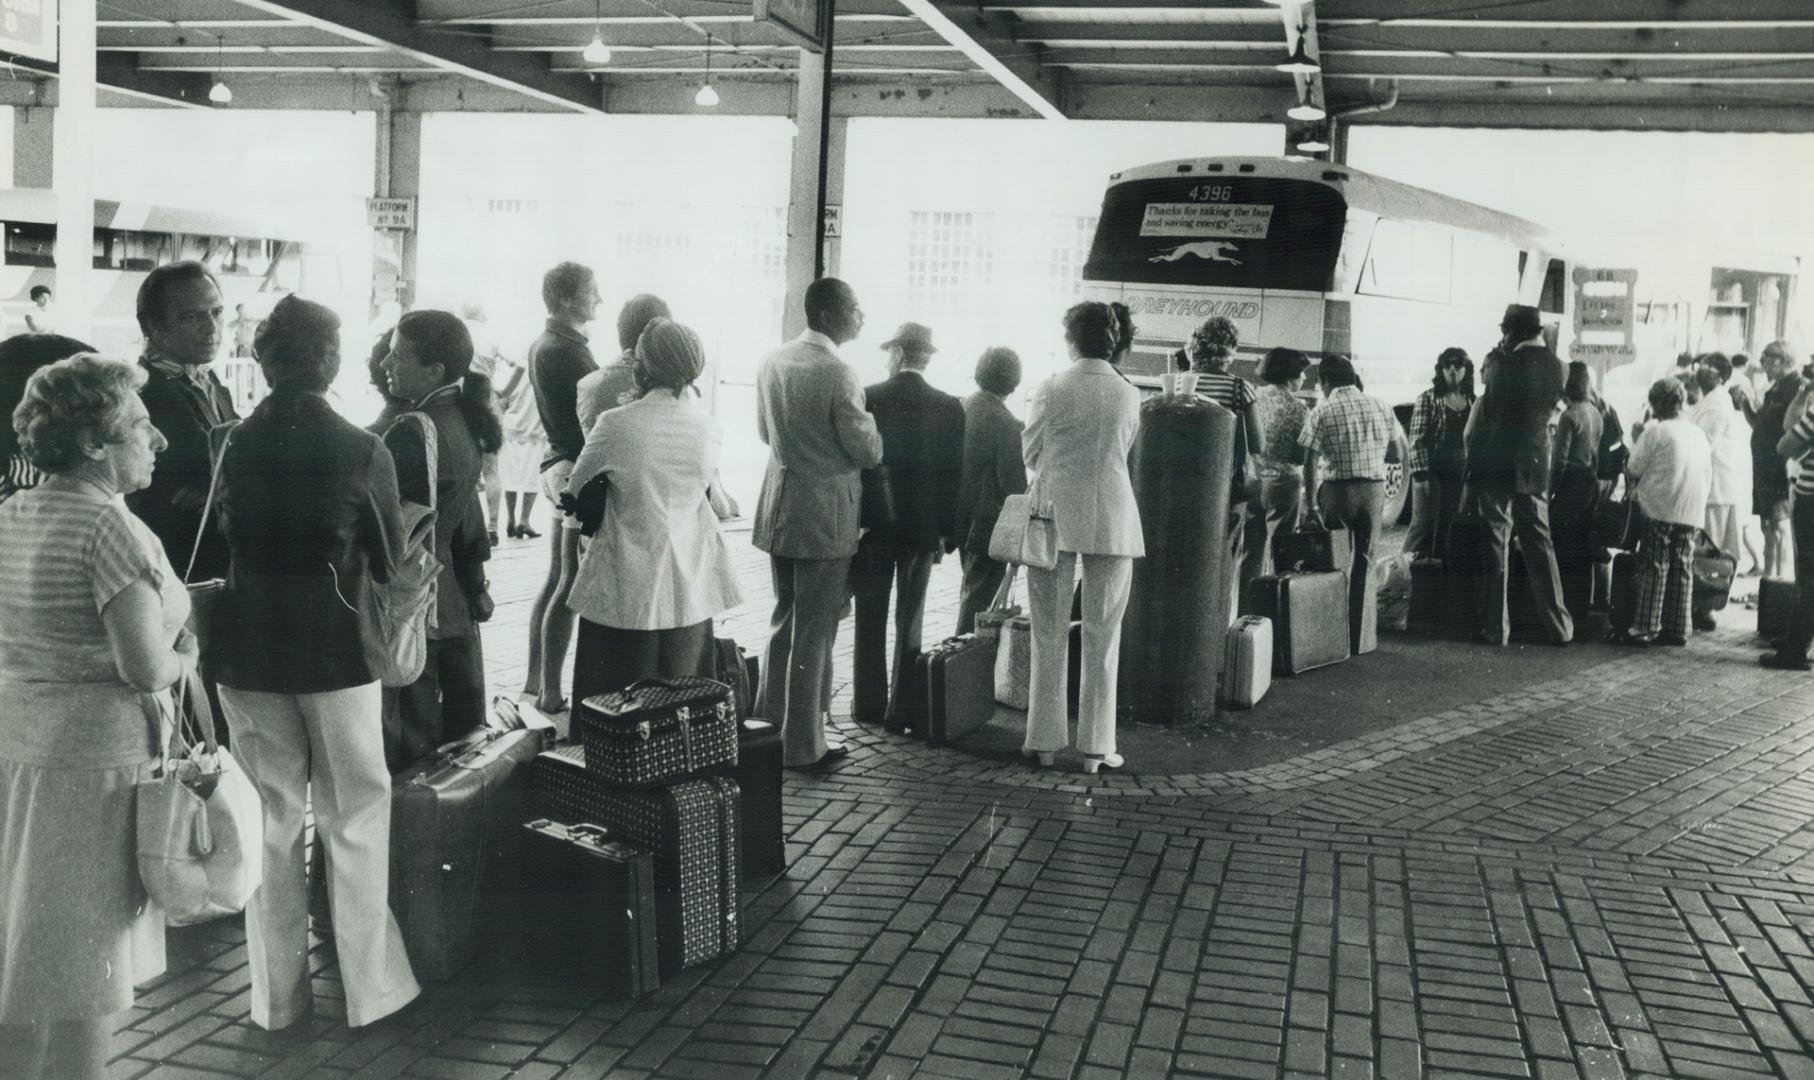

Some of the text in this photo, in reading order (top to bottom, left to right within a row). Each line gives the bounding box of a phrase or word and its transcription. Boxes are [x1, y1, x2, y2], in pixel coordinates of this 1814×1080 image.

[1188, 186, 1233, 200] 4396
[369, 202, 408, 212] PLATFORM
[1149, 206, 1182, 217] Thanks
[1183, 207, 1198, 216] for
[1199, 206, 1231, 218] taking
[1234, 207, 1250, 217] the
[824, 208, 838, 219] RM
[1145, 219, 1162, 227] and
[1165, 219, 1194, 229] saving
[1128, 296, 1259, 319] GREYHOUND
